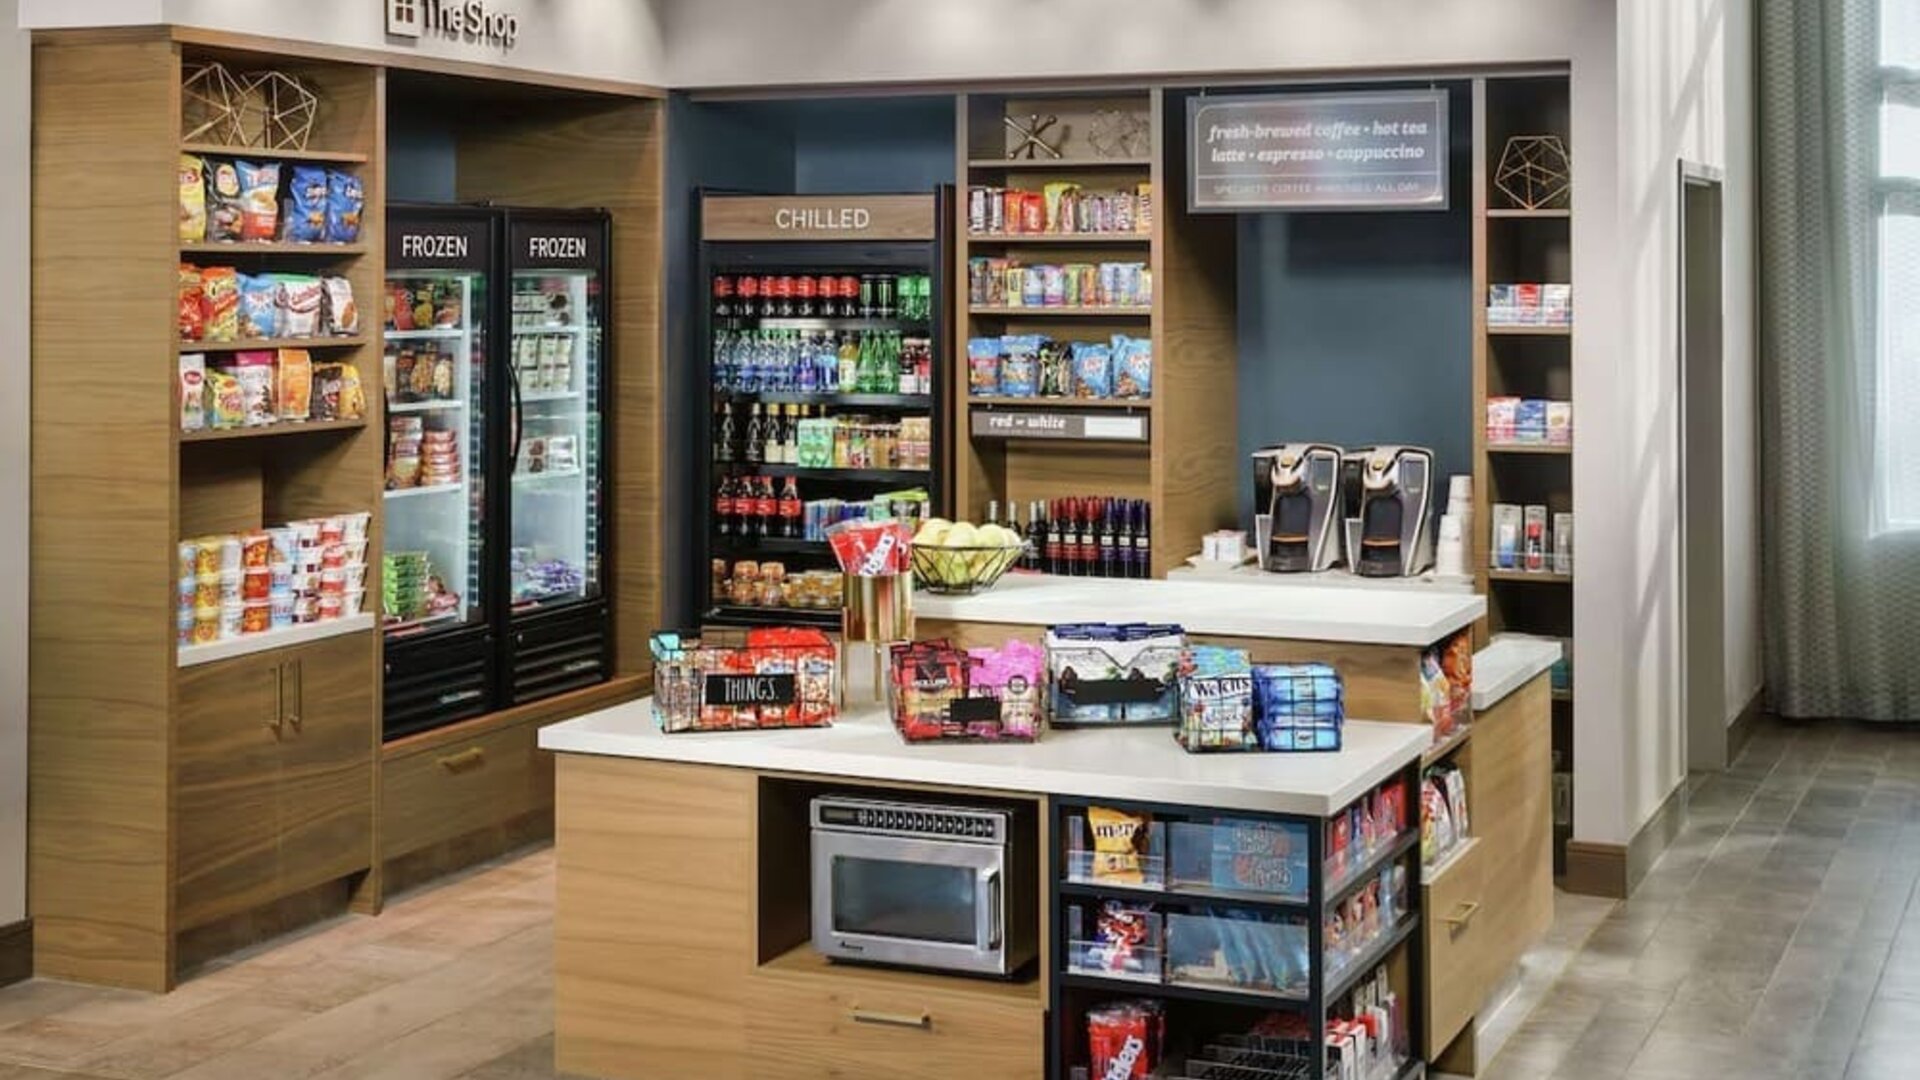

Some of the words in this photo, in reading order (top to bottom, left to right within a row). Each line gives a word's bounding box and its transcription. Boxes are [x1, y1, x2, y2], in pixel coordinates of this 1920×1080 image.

[1207, 123, 1311, 143] fresh-brewed
[1314, 121, 1361, 141] coffee
[1373, 120, 1398, 136] hot
[1402, 121, 1428, 135] tea
[1211, 147, 1246, 162] latte
[1257, 147, 1324, 165] espresso
[1335, 143, 1425, 163] cappuccino
[775, 208, 870, 229] CHILLED
[402, 235, 468, 257] FROZEN
[529, 237, 587, 258] FROZEN
[989, 415, 1013, 428] red
[1027, 415, 1067, 430] white
